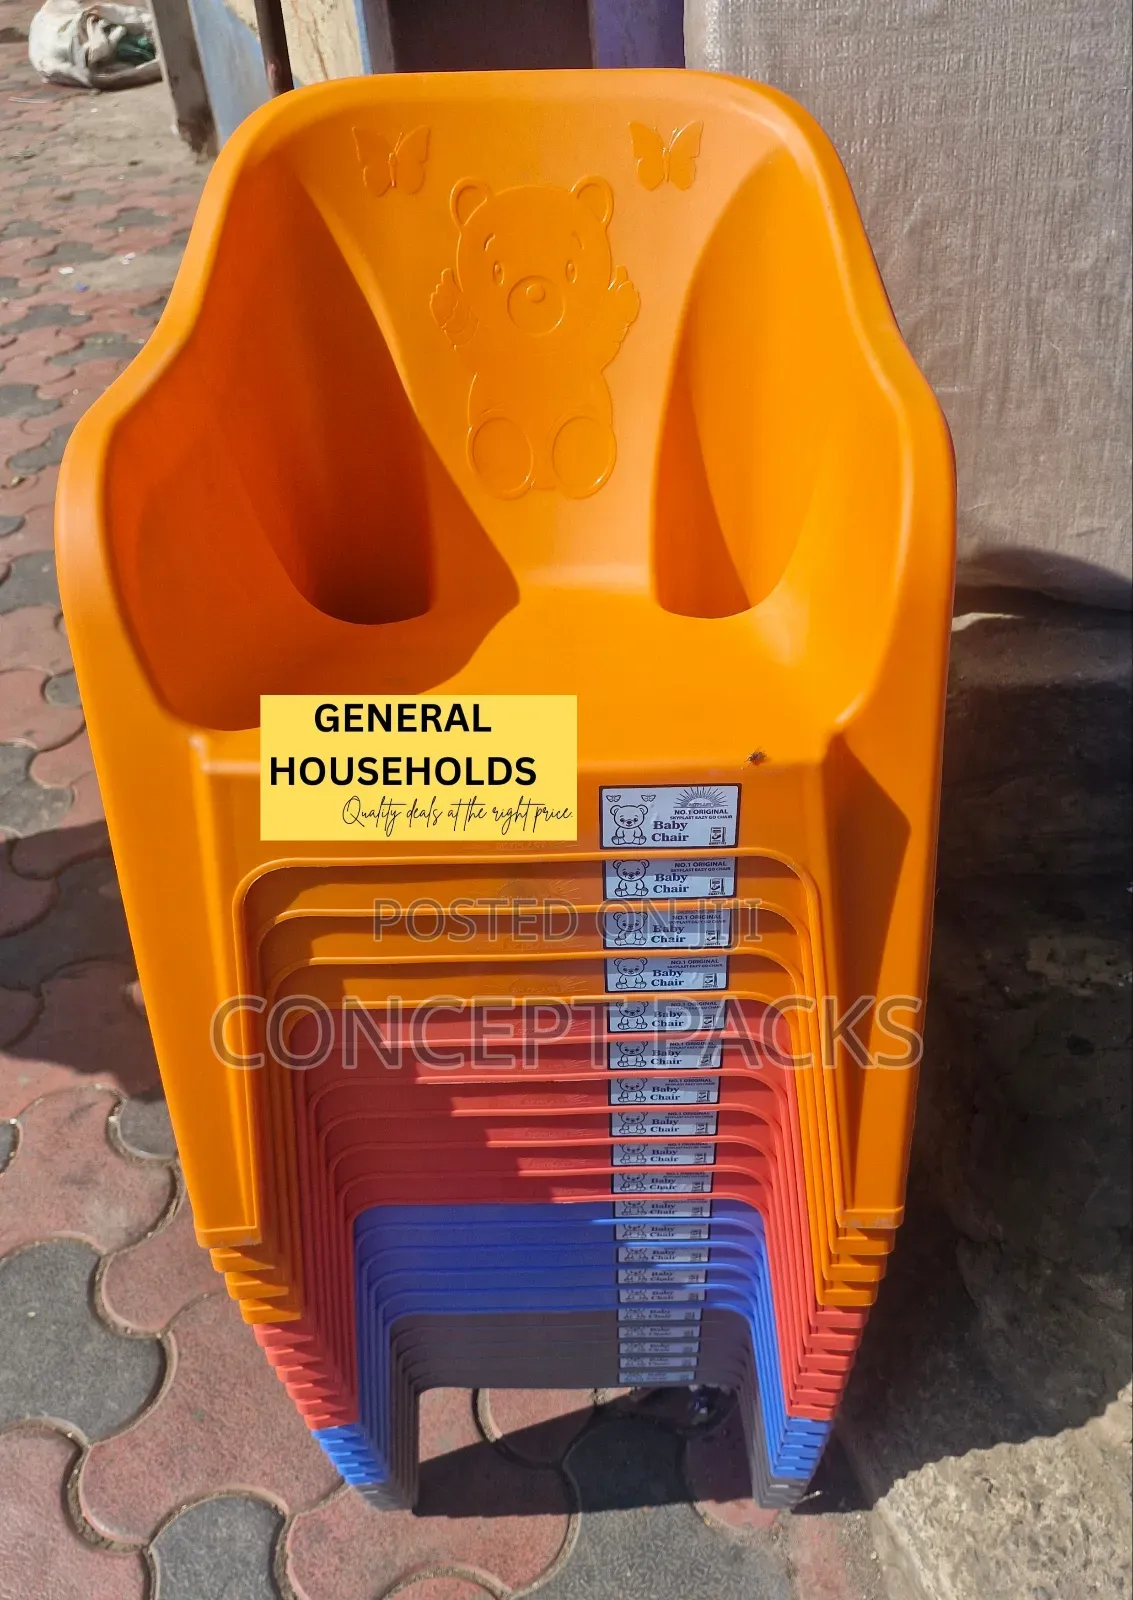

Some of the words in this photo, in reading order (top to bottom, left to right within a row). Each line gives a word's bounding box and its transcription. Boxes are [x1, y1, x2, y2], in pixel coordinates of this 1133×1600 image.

[653, 820, 688, 831] Baby
[651, 832, 689, 842] Chair
[654, 873, 688, 883] Baby
[653, 884, 689, 893] Chair
[652, 924, 684, 934] Baby
[651, 935, 686, 943] Chair
[652, 969, 684, 979] Baby
[651, 979, 684, 987] Chair
[653, 1011, 683, 1019] Baby
[651, 1019, 684, 1027] Chair
[651, 1049, 681, 1057] Baby
[651, 1086, 680, 1094] Baby
